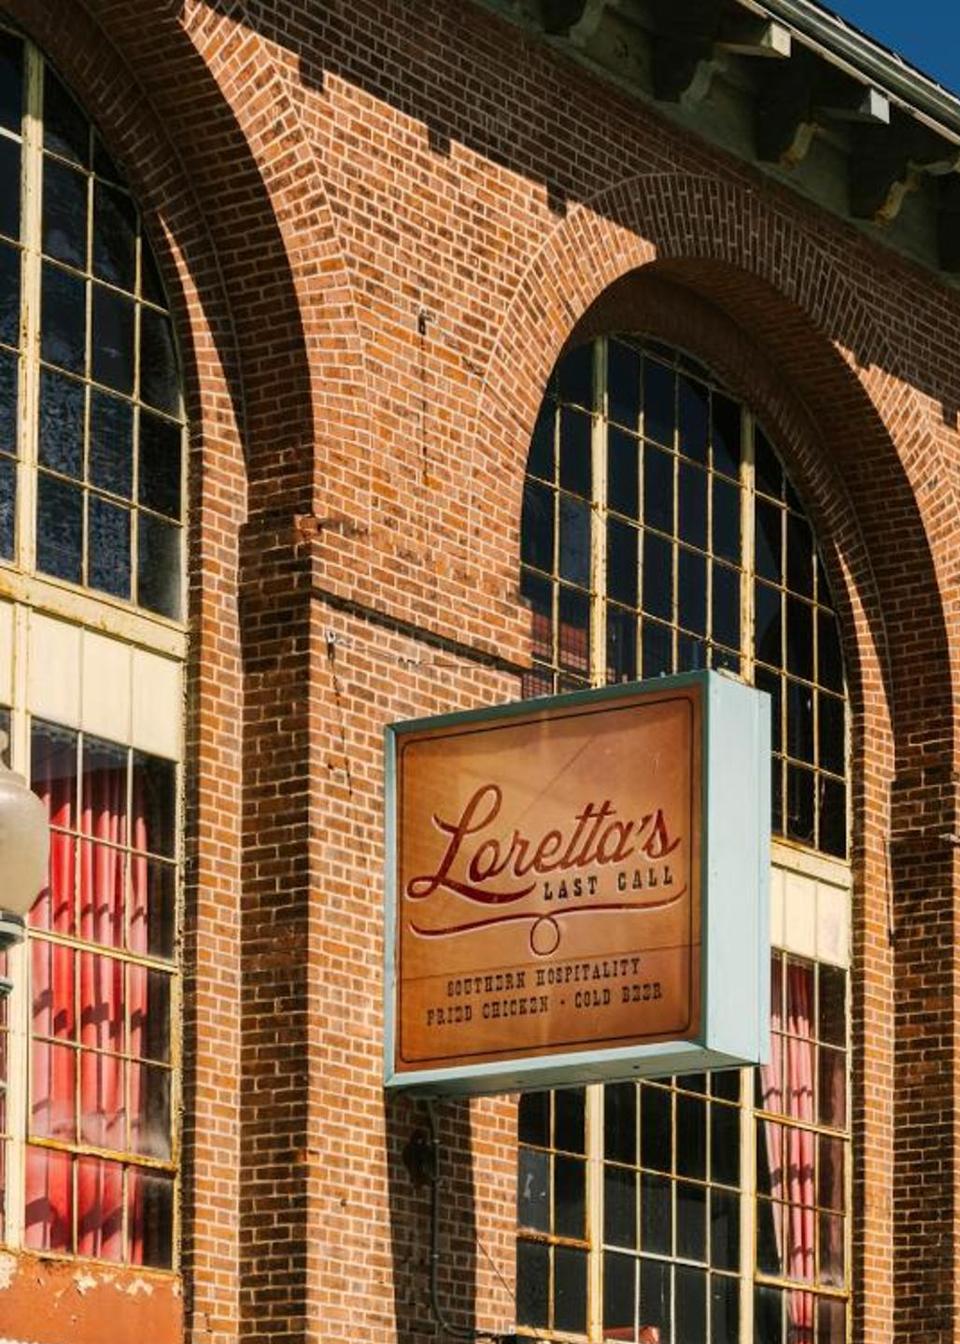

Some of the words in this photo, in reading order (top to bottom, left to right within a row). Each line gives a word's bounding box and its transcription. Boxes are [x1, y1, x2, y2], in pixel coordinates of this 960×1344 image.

[406, 784, 682, 904] Loretta's
[543, 875, 598, 901] LAST
[618, 865, 673, 891] CALL
[447, 971, 526, 997] SOUTHERN
[536, 957, 642, 987] HOSPITALITY
[427, 1004, 473, 1026] FRIED
[482, 996, 549, 1020] CHICKEN
[574, 989, 611, 1008] COLD
[622, 982, 662, 1003] BEER
